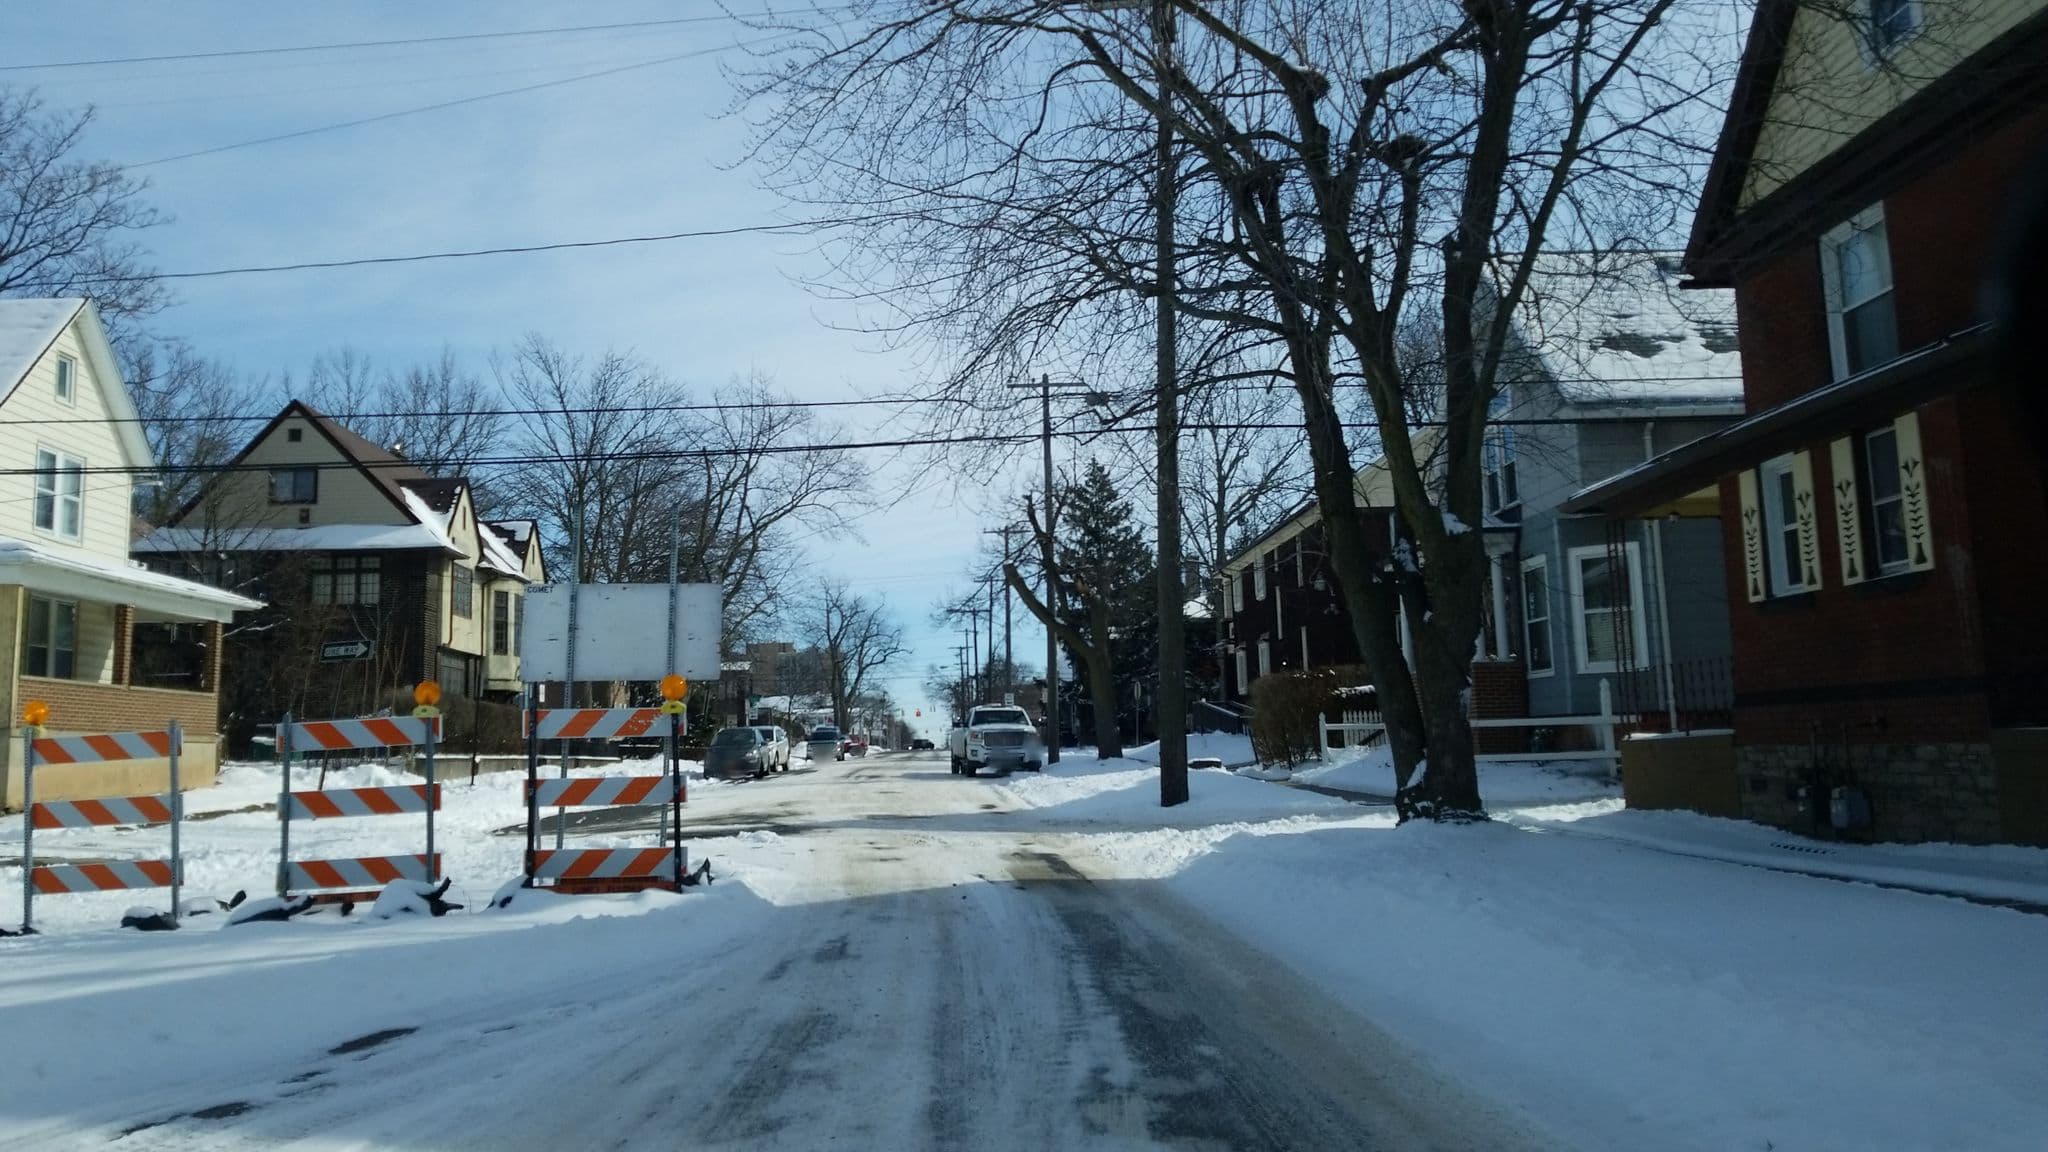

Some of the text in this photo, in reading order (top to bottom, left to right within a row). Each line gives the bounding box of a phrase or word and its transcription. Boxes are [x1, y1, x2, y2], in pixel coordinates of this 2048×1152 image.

[527, 586, 553, 594] COMET
[325, 646, 358, 656] ONE WAY
